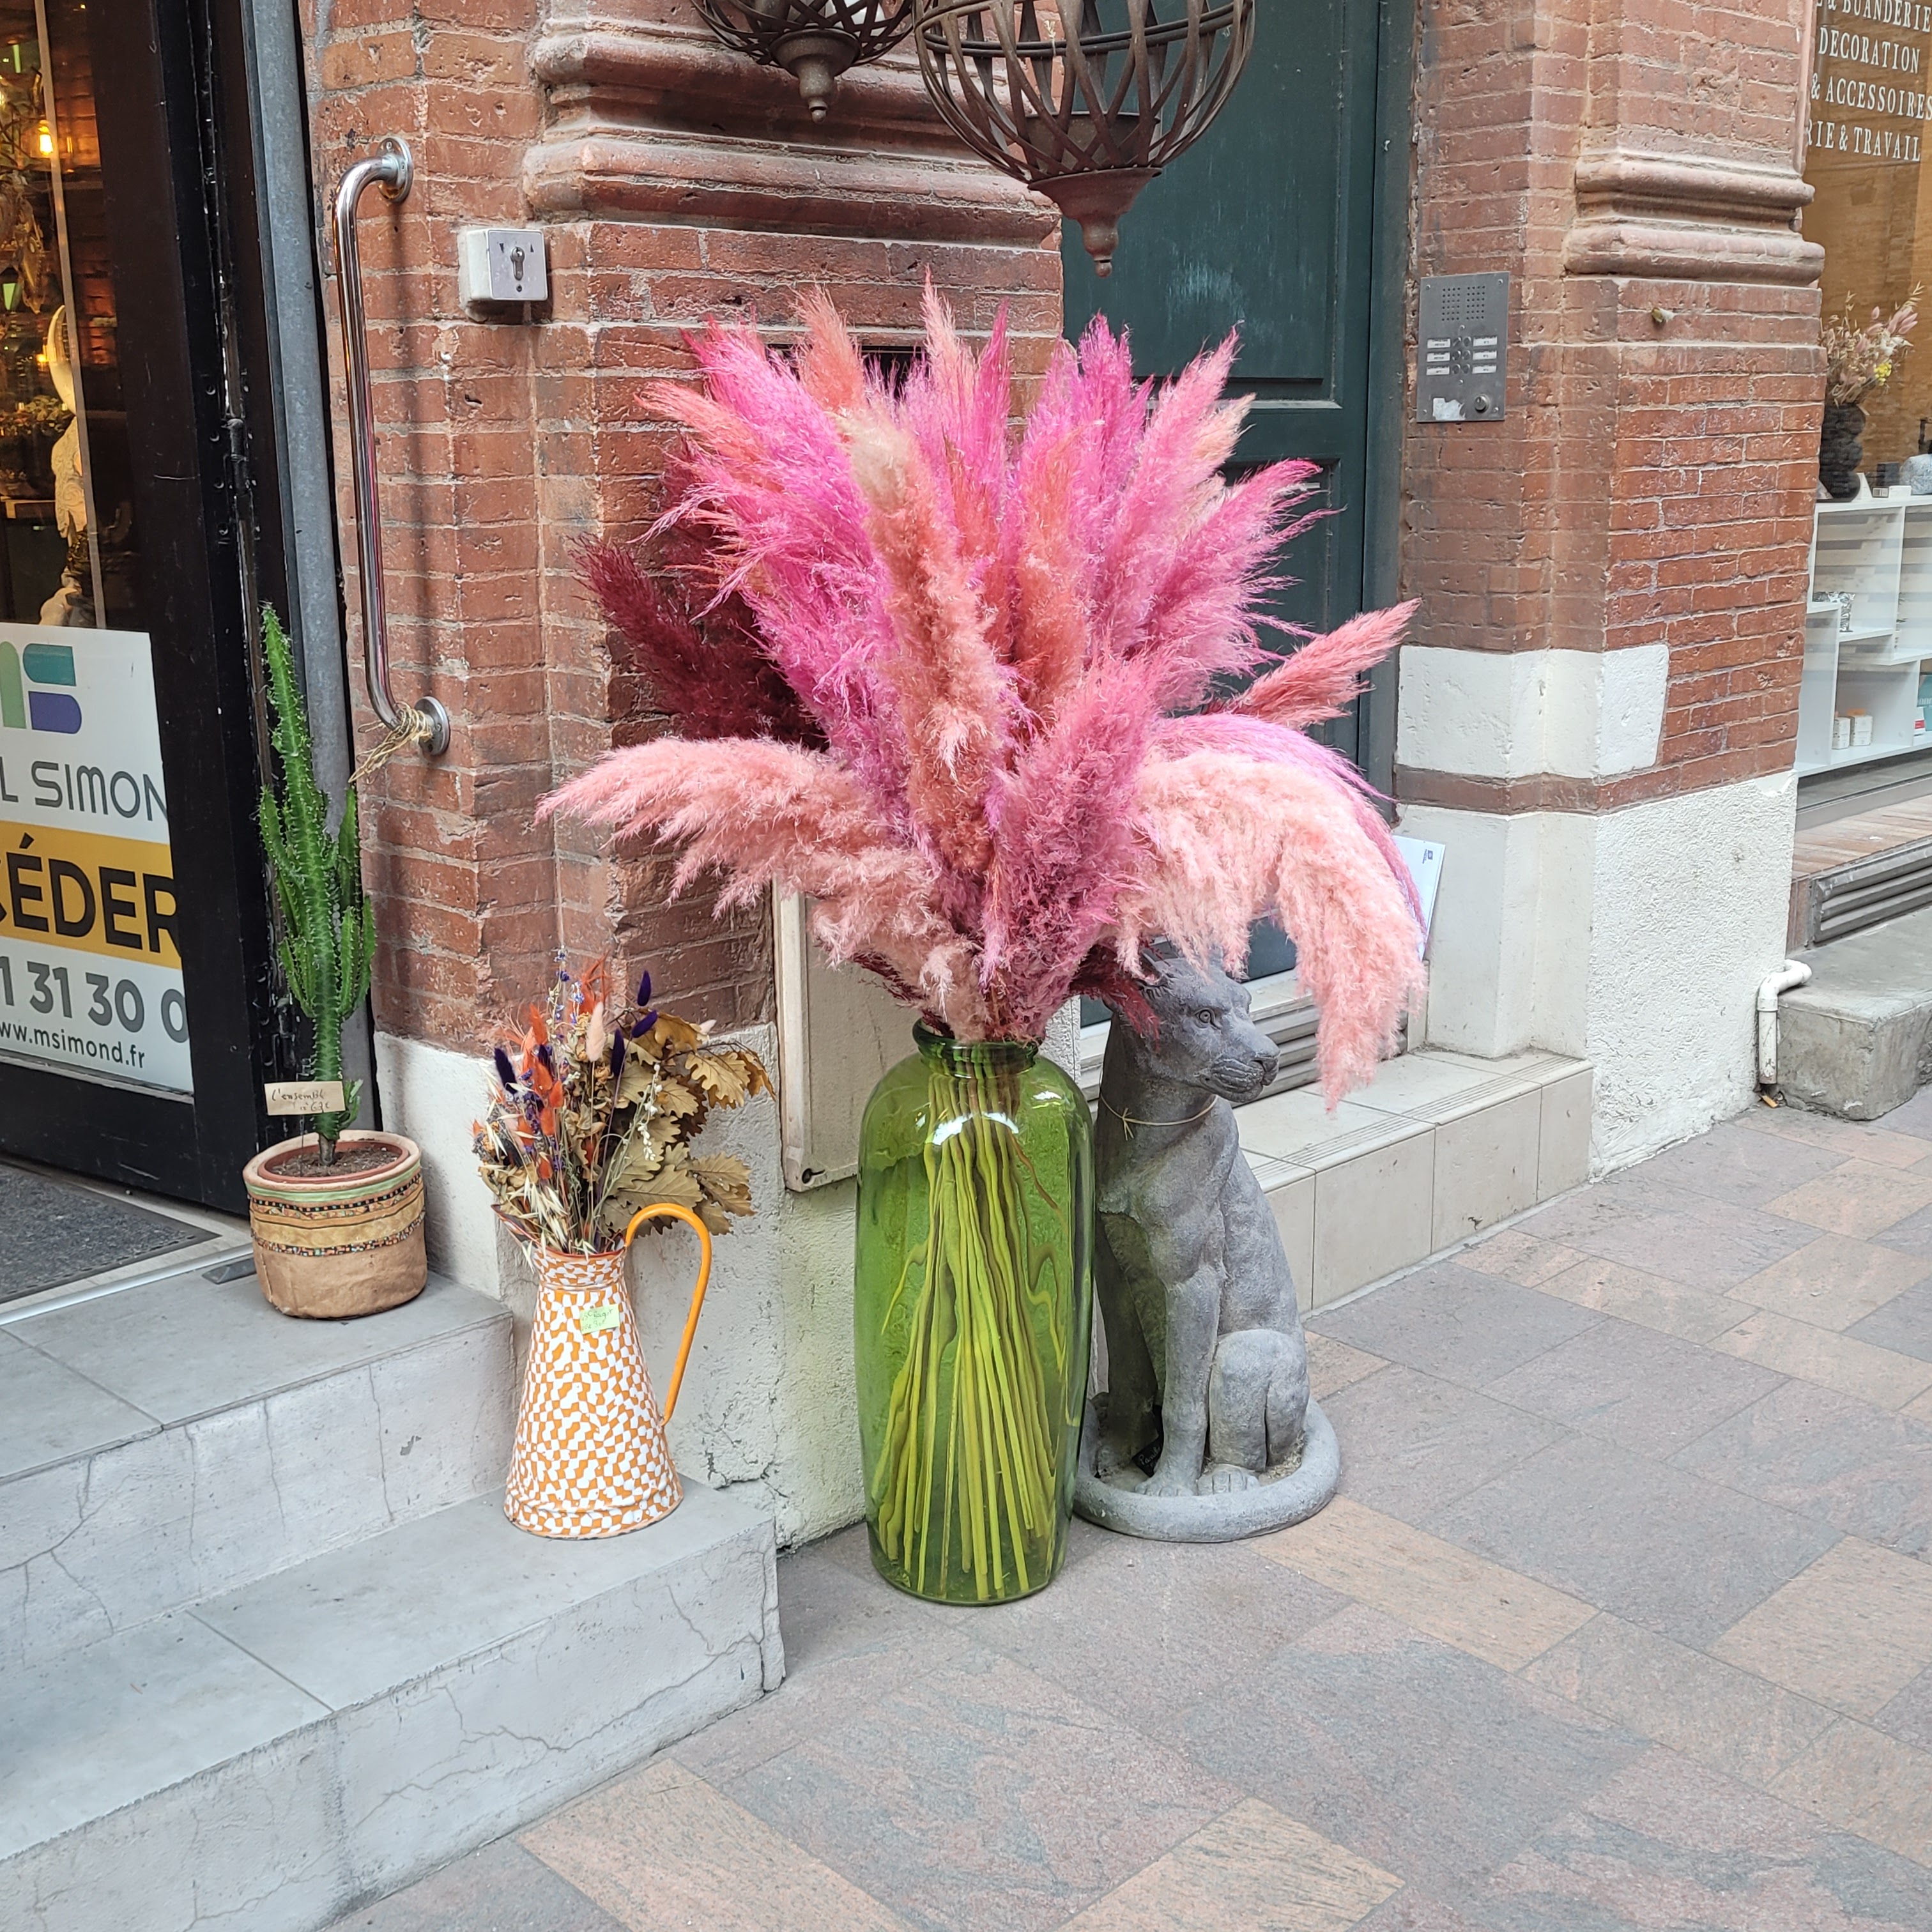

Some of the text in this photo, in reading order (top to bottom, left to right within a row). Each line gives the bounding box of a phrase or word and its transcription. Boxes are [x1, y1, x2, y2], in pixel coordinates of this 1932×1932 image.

[1843, 0, 1931, 33] BUANDERIE
[1818, 27, 1920, 74] DECORATION
[1811, 72, 1932, 121] & ACCESSOIRES
[1839, 124, 1848, 152] &
[1854, 126, 1920, 162] TRAVAIL
[0, 832, 181, 957] ÉDER
[27, 960, 72, 1018] 31
[86, 972, 145, 1033] 30
